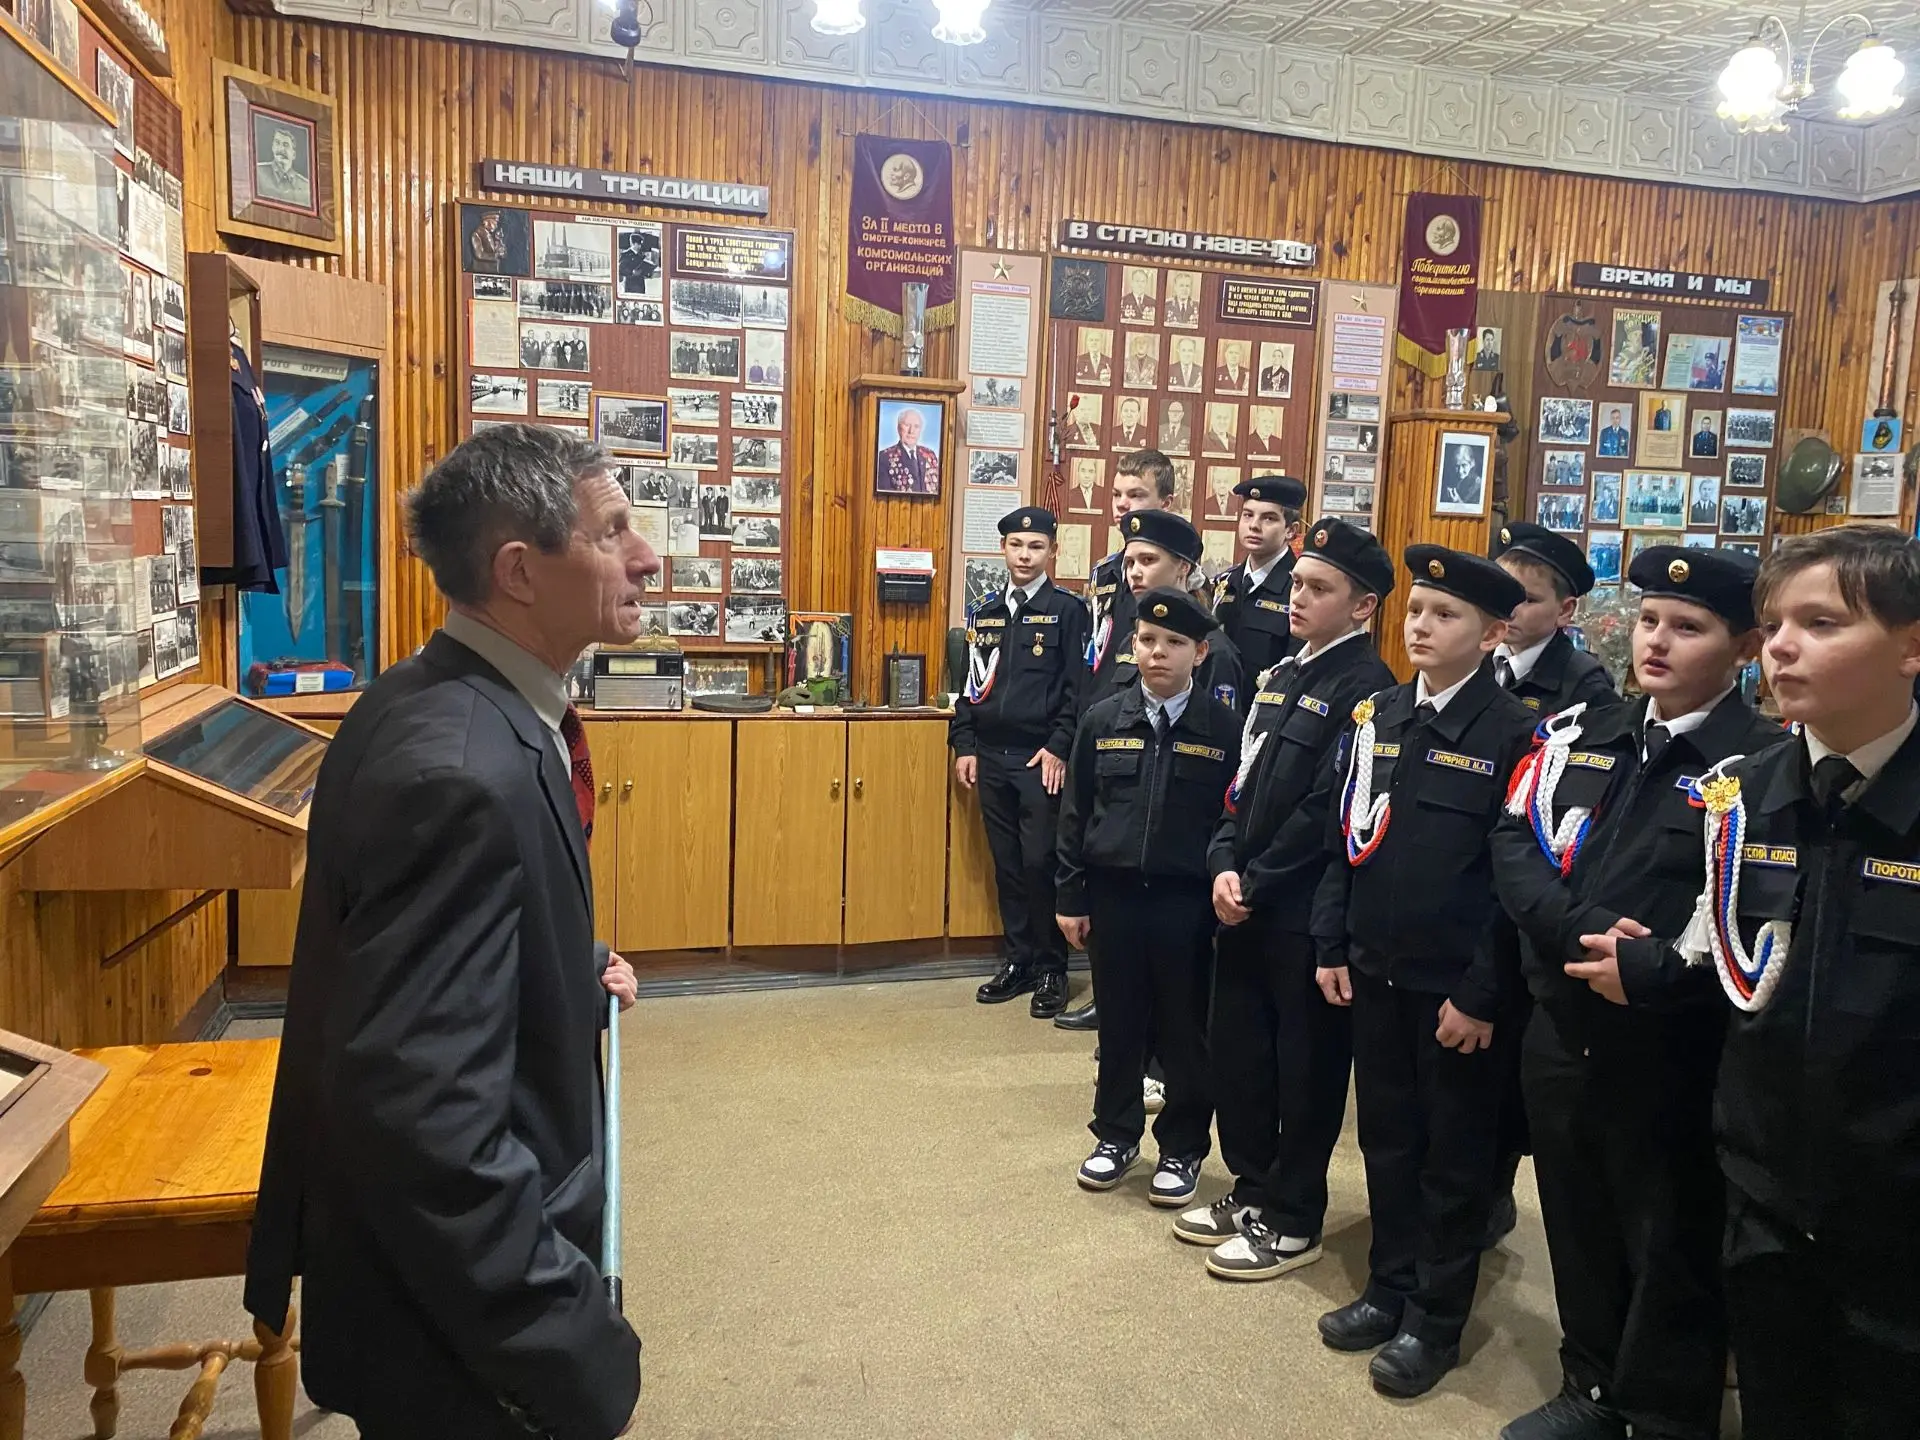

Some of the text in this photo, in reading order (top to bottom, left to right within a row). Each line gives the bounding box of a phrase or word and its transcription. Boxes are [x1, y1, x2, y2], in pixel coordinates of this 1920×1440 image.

[494, 163, 760, 207] НАШИ ТРАДИЦИИ
[893, 221, 931, 234] МЕСТО
[934, 223, 943, 235] В
[862, 232, 946, 248] СМОТРЕ-КОНКУРСЕ
[1069, 222, 1315, 261] В СТРОЮ НАВЕЧНО
[857, 246, 952, 265] КОМСОМОЛЬСКИХ
[866, 262, 944, 277] ОРГАНИЗАЦИЙ
[1411, 258, 1471, 277] Победителю
[1600, 267, 1752, 295] ВРЕМЯ И МЫ
[1434, 753, 1488, 771] АНУФРИЕВ М.А.
[1570, 754, 1612, 769] ТСКИЙ КЛАСС
[1770, 850, 1795, 862] КЛАСС
